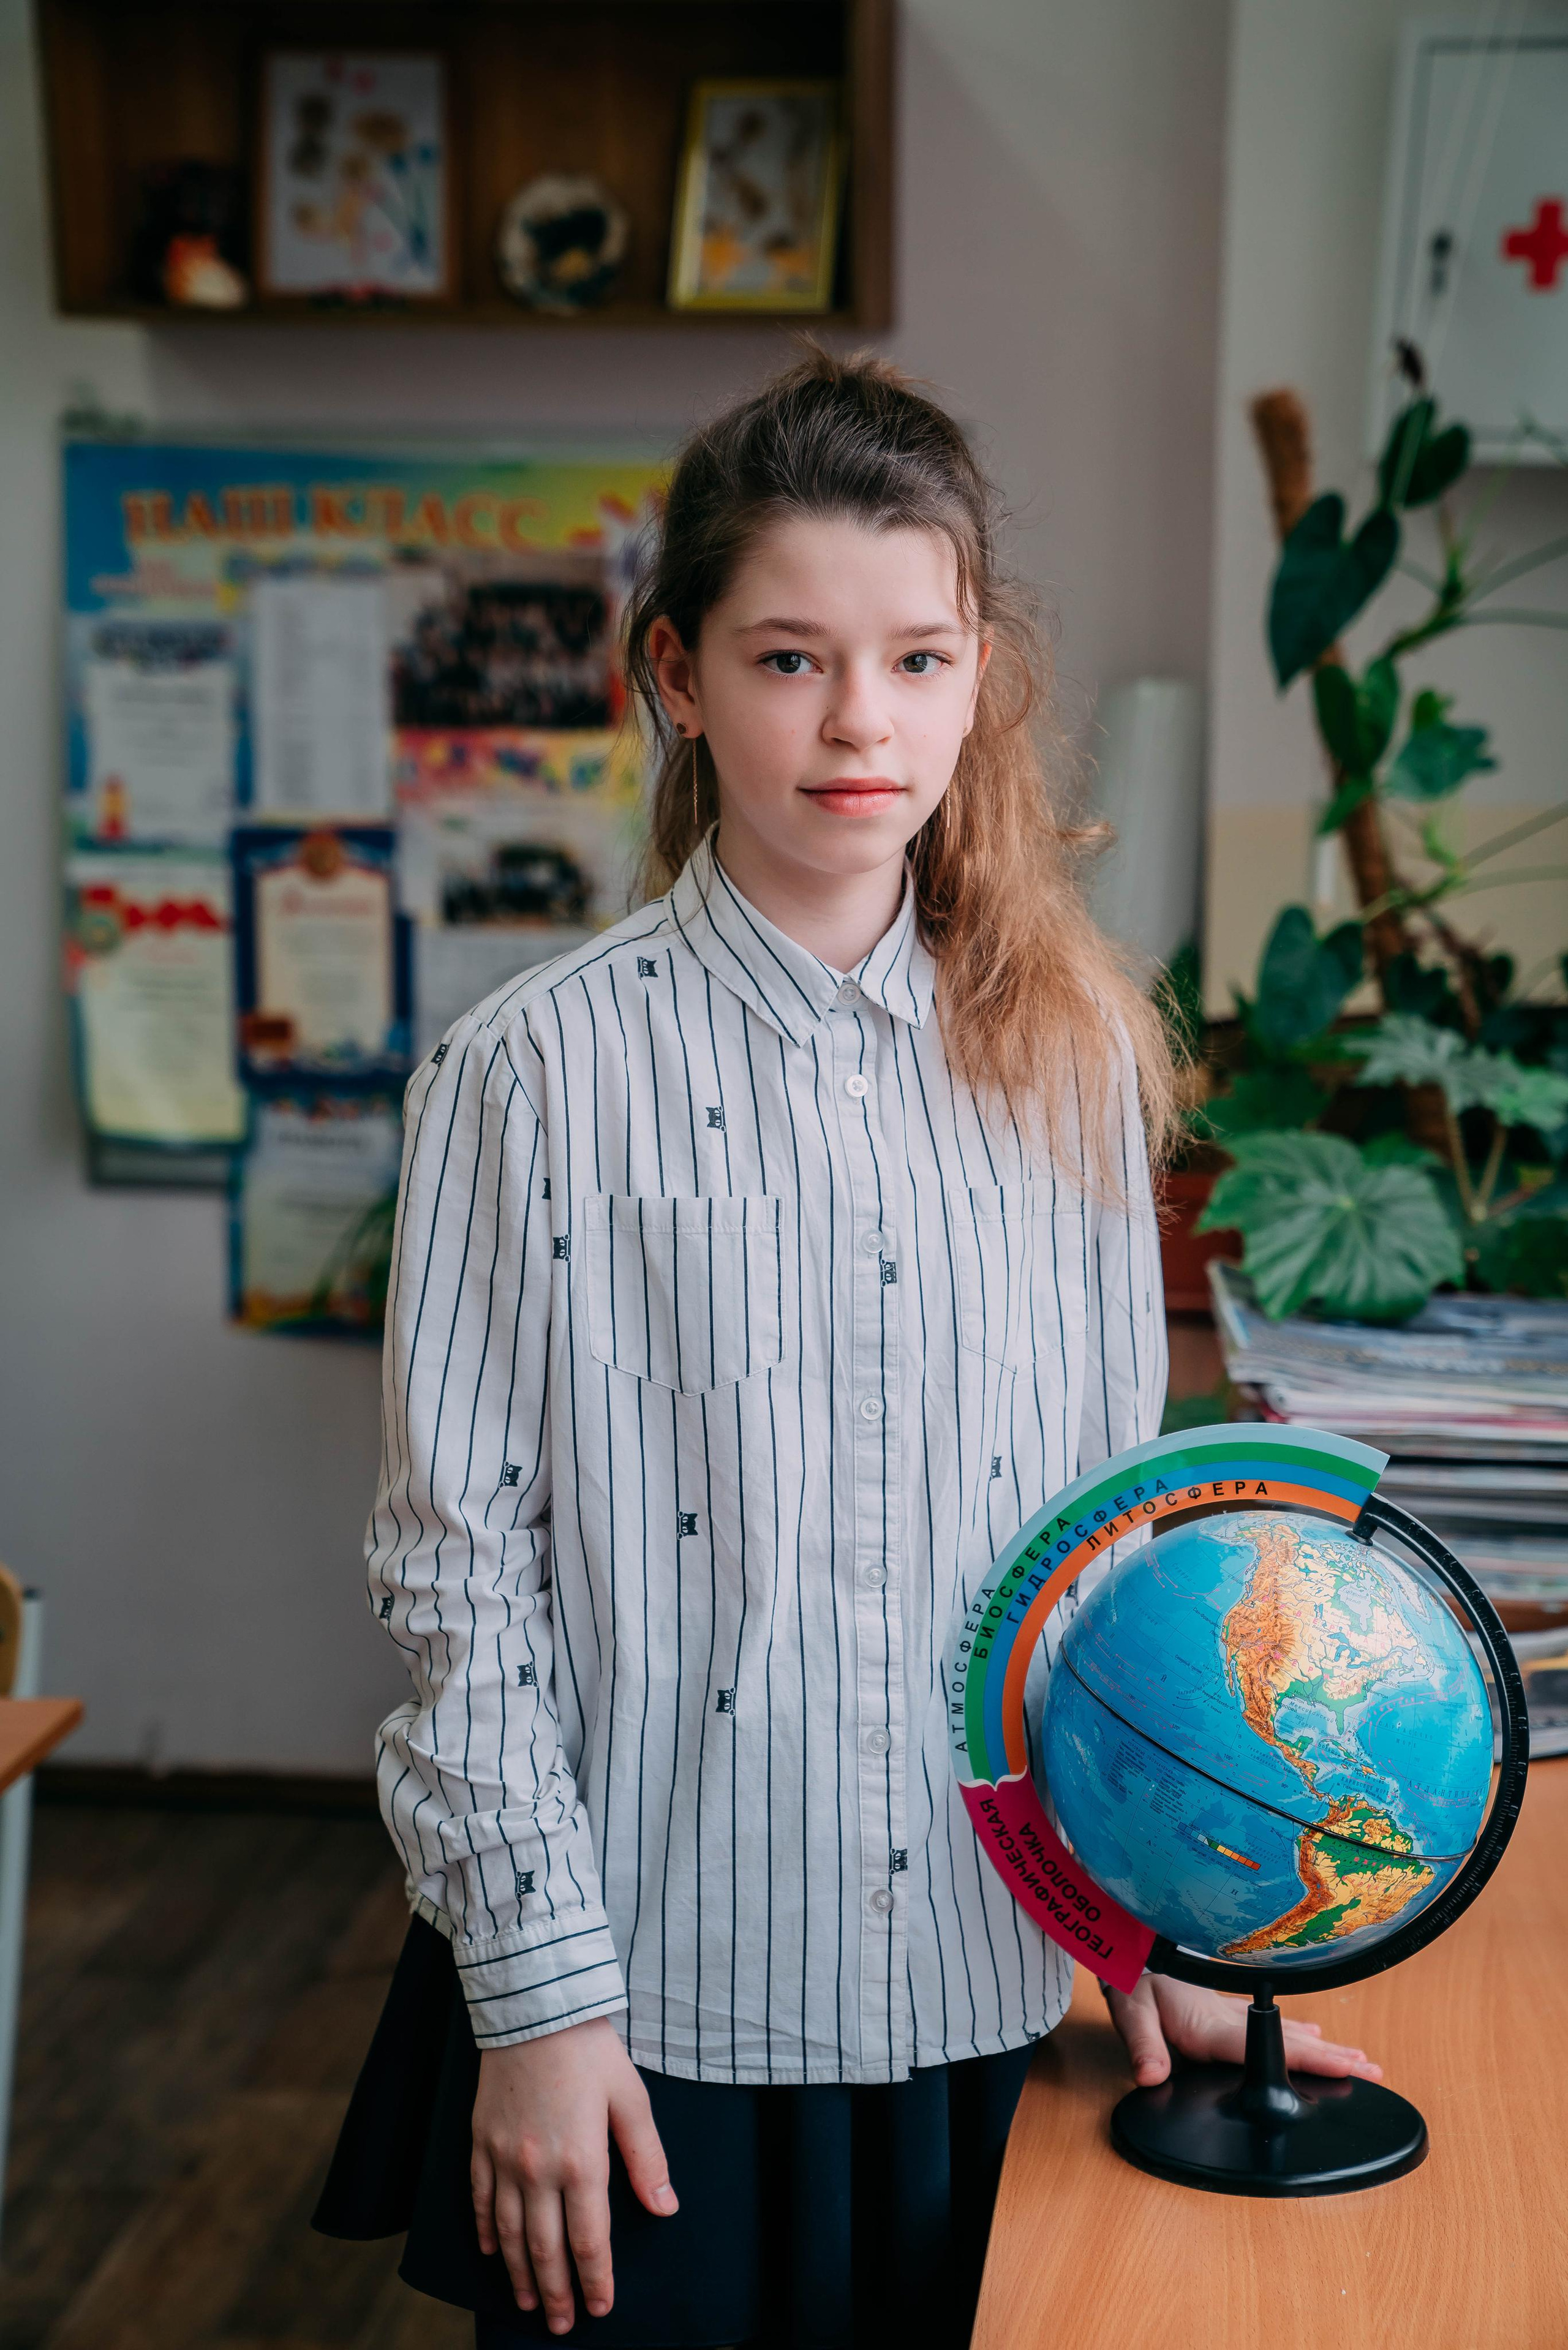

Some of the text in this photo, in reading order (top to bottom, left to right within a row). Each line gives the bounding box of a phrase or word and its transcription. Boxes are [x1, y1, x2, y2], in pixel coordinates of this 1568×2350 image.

[314, 489, 549, 554] КЛАСС
[1007, 1479, 1168, 1624] ГИДРОСФЕРА
[1086, 1481, 1268, 1551] ЛИТОСФЕРА
[974, 1517, 1071, 1659] БИОСФЕРА
[1193, 1607, 1221, 1630] Сан-Франциско
[951, 1587, 995, 1752] АТМОСФЕРА
[1289, 1701, 1335, 1723] Мексиканский
[979, 1798, 1114, 1960] ГЕОГРАФИЧЕСКАЯ
[1019, 1821, 1101, 1922] ОБОЛОЧКА
